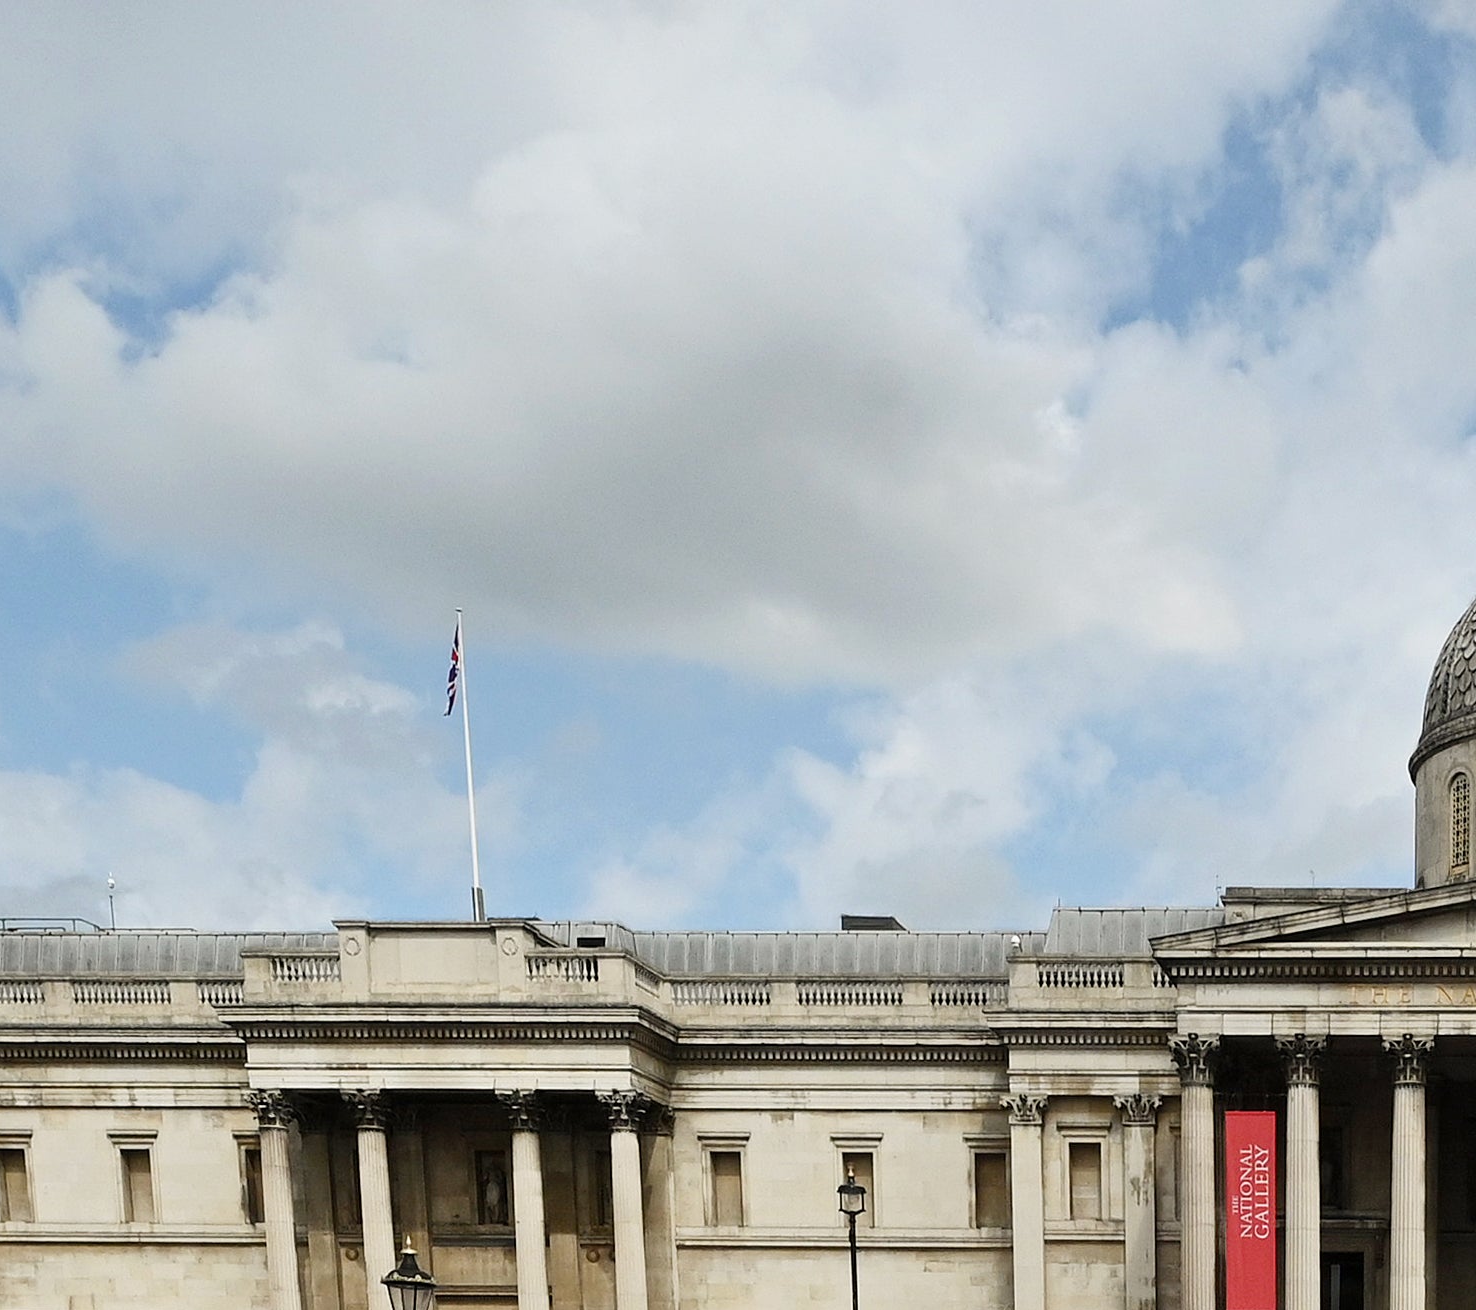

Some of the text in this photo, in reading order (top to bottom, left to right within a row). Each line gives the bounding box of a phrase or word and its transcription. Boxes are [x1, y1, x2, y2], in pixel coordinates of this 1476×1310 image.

[1346, 985, 1412, 1005] THE
[1232, 1195, 1240, 1215] THE
[1239, 1143, 1253, 1238] NATIONAL
[1254, 1144, 1270, 1239] GALLERY
